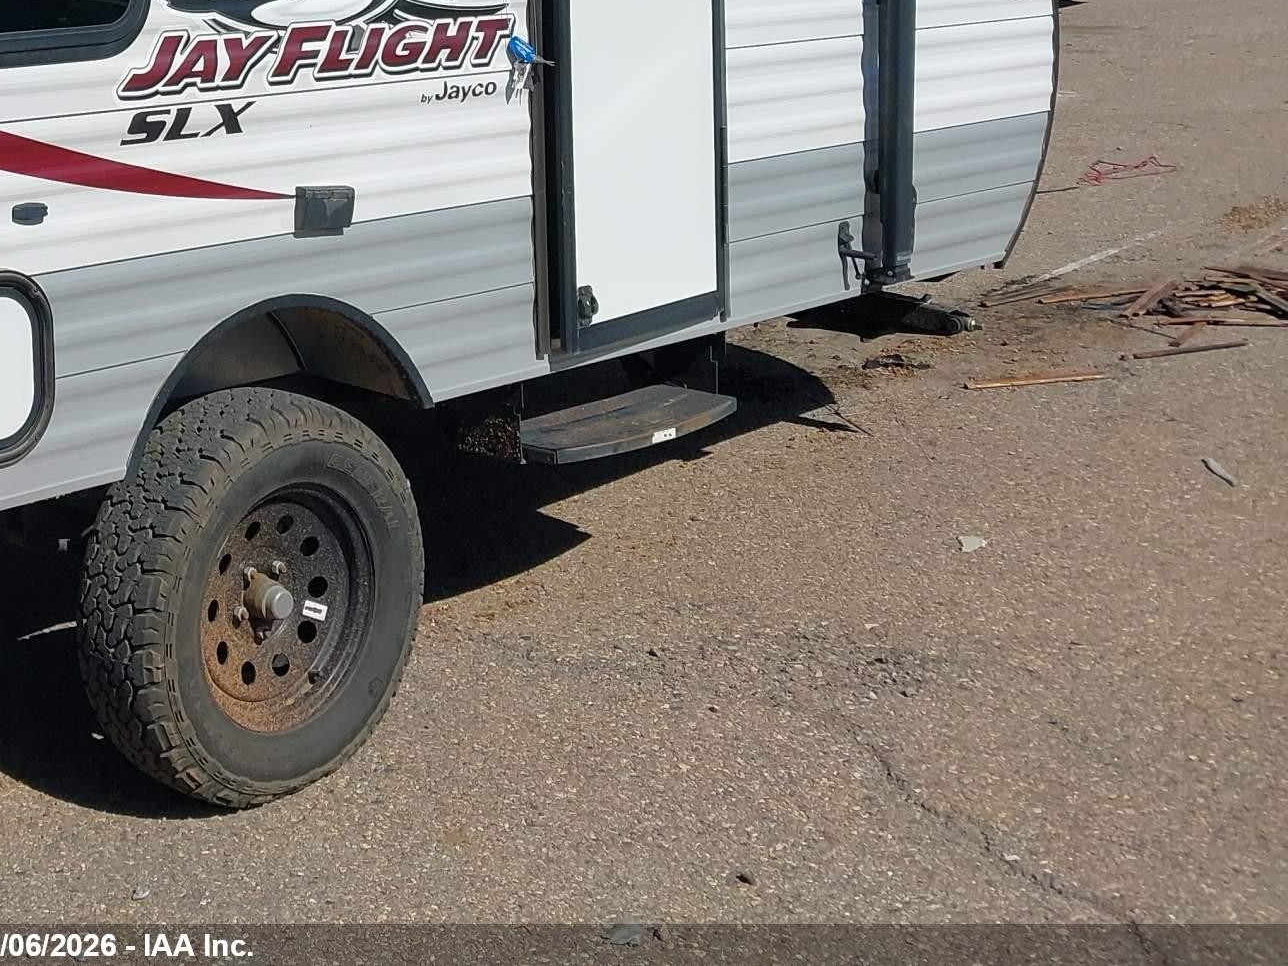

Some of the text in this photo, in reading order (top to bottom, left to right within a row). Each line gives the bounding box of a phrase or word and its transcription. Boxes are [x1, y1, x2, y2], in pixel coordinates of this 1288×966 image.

[118, 15, 512, 97] JAY FLIGHT
[421, 81, 497, 104] by Jayco
[120, 101, 256, 146] SLX
